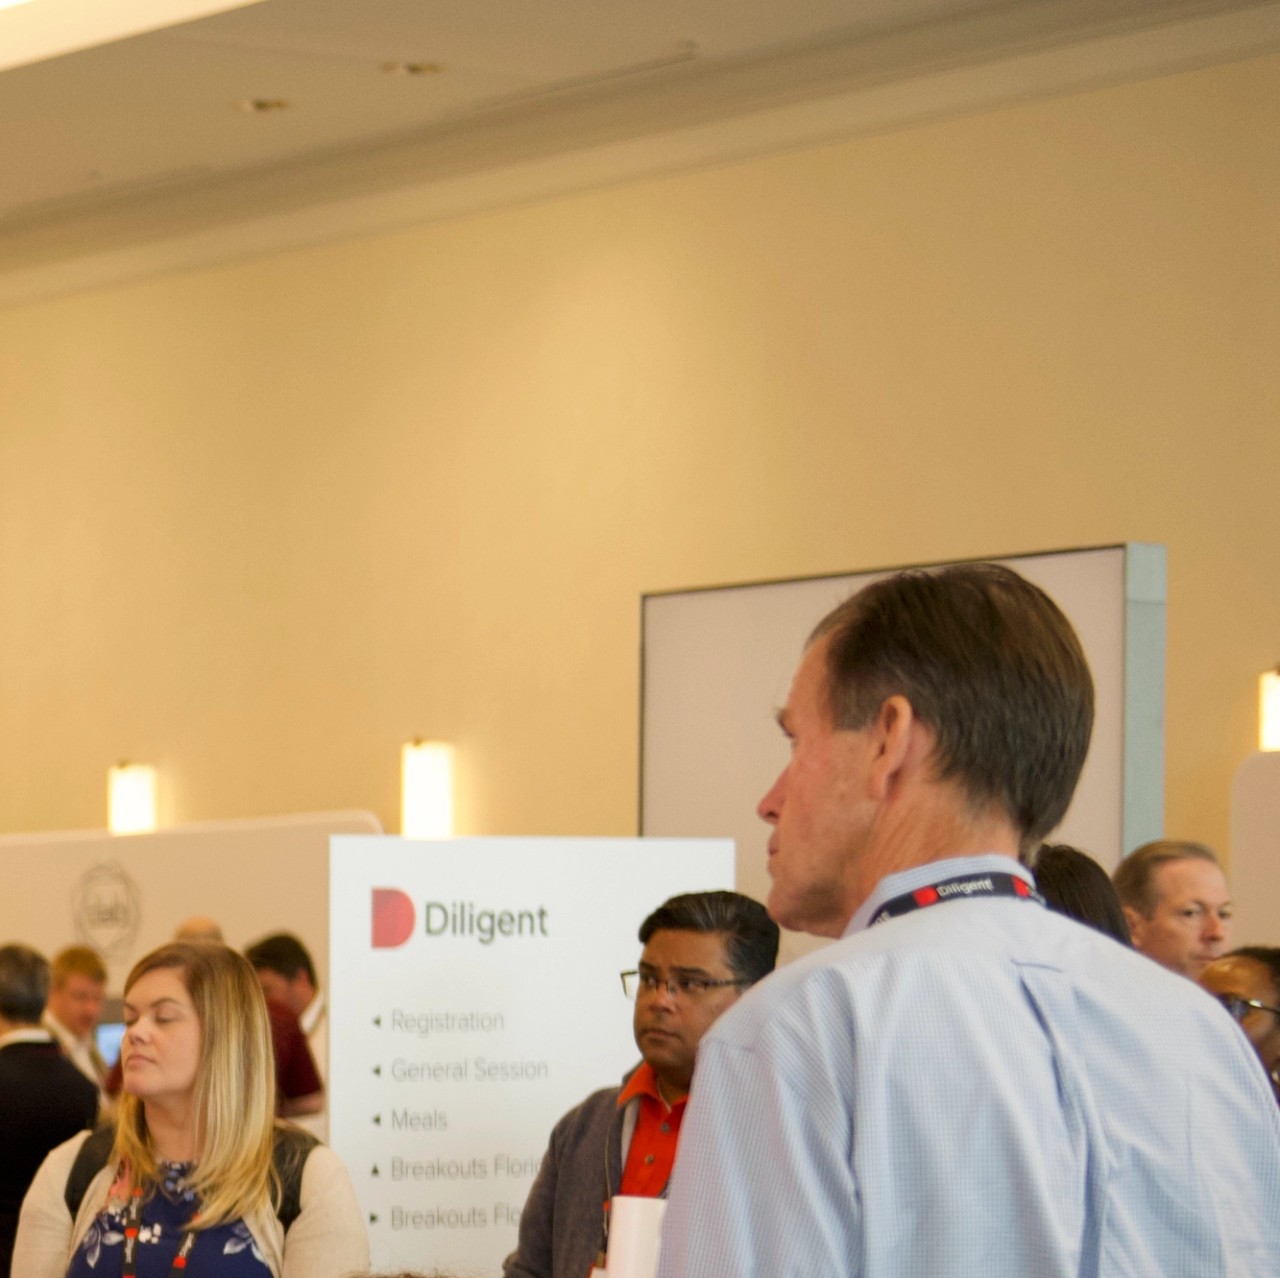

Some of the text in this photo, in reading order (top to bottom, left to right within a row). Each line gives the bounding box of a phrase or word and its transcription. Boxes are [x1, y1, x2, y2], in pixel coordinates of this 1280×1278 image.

[937, 878, 993, 896] Diligent
[425, 902, 548, 945] Diligent
[391, 1009, 505, 1037] Registration
[391, 1056, 549, 1082] General Session
[391, 1109, 448, 1131] Meals
[391, 1156, 488, 1182] Breakouts
[391, 1205, 488, 1231] Breakouts
